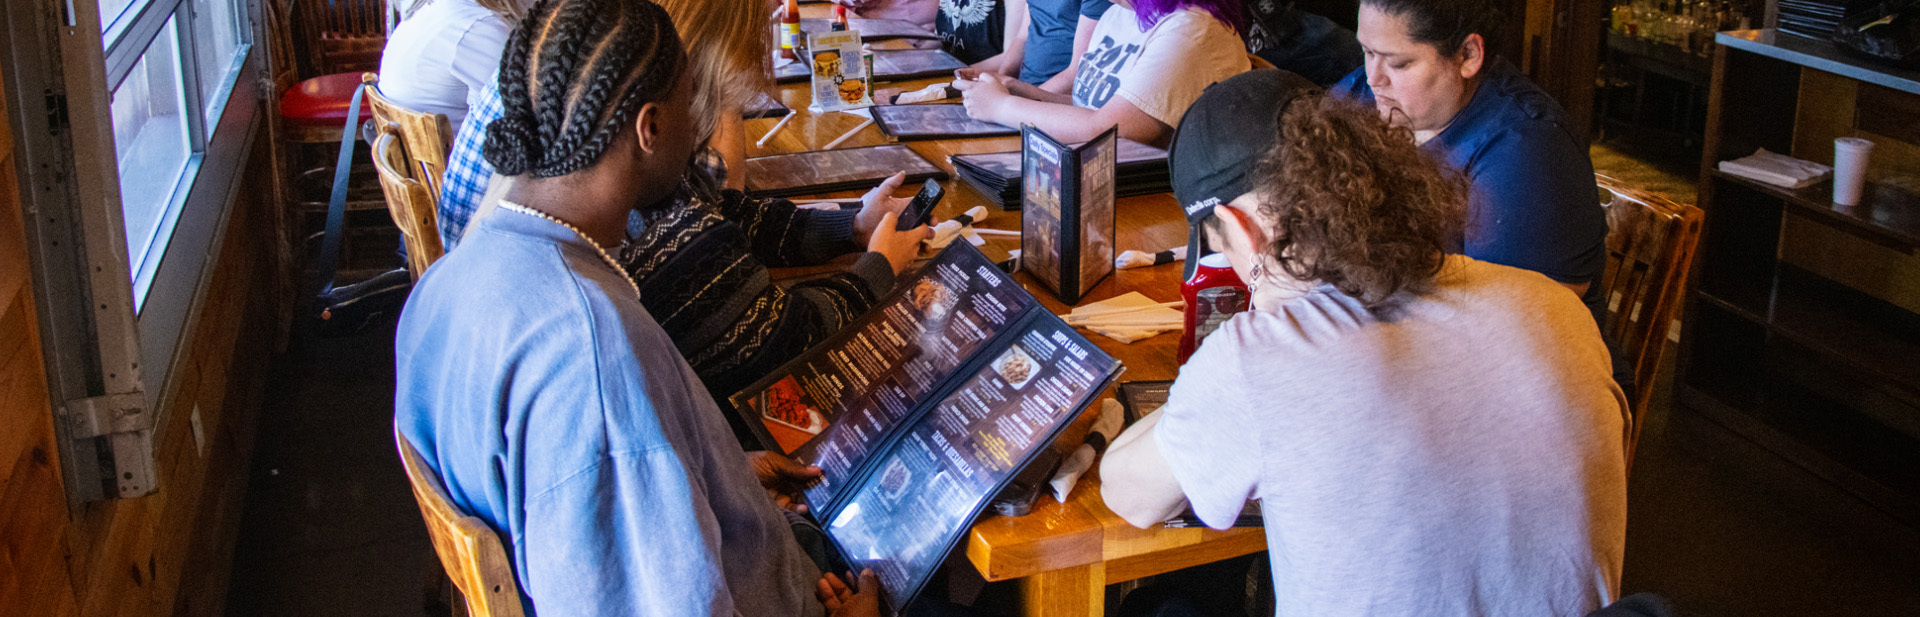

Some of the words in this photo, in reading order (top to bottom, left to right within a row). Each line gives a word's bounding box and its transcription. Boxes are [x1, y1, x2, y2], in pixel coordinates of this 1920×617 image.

[950, 263, 959, 271] FRIED
[958, 270, 969, 280] PICKLES
[976, 265, 1001, 287] STARTERS
[896, 303, 908, 314] PULLED
[906, 314, 915, 322] PORK
[996, 303, 1006, 311] BITES
[882, 321, 894, 333] BACON
[963, 317, 978, 331] CRAWFISH
[976, 329, 986, 338] TAILS
[857, 332, 874, 350] ULTIMATE
[1051, 330, 1068, 345] SOUPS
[1064, 340, 1072, 348] &
[1068, 343, 1088, 360] SALADS
[838, 350, 849, 362] FRIED
[847, 362, 869, 386] MUSHROOMS
[830, 374, 844, 389] WINGS
[1050, 376, 1062, 387] CHICKEN
[930, 430, 946, 447] TACOS
[942, 442, 949, 450] &
[945, 446, 973, 478] QUESADILLAS
